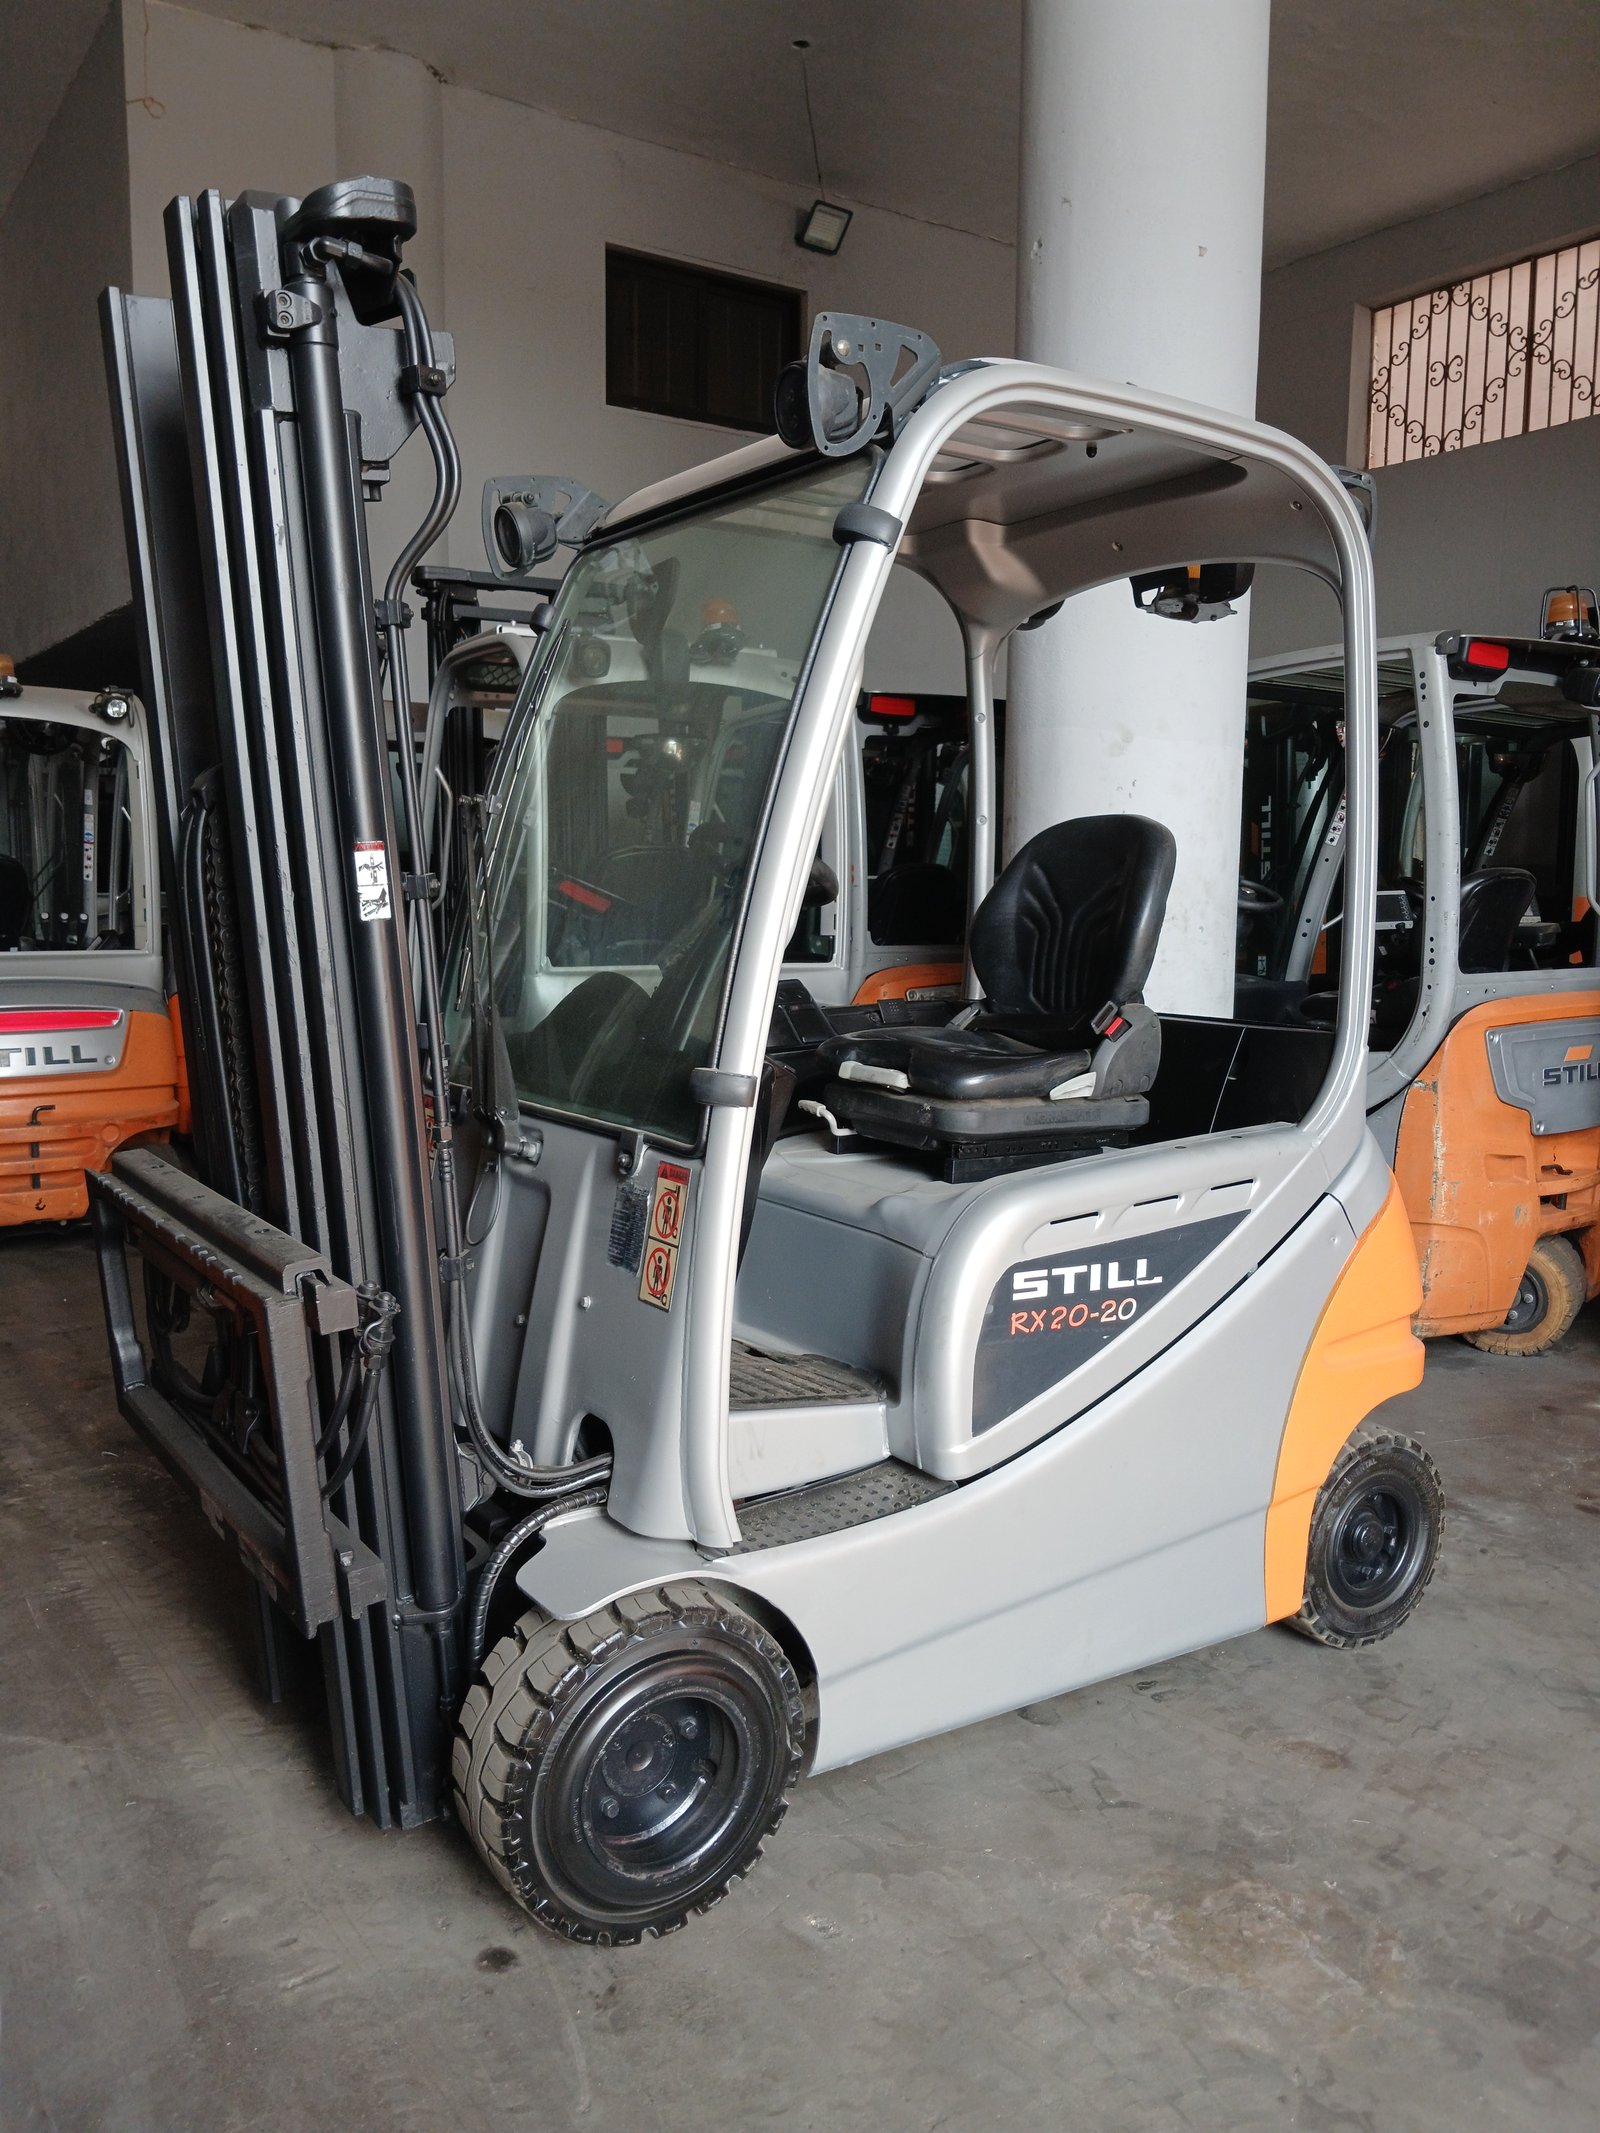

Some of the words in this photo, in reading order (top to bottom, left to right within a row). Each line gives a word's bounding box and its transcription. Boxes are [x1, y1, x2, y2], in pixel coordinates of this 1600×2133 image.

[1261, 795, 1272, 880] STILL
[1542, 1062, 1600, 1087] STIL
[1012, 1258, 1163, 1301] STILL
